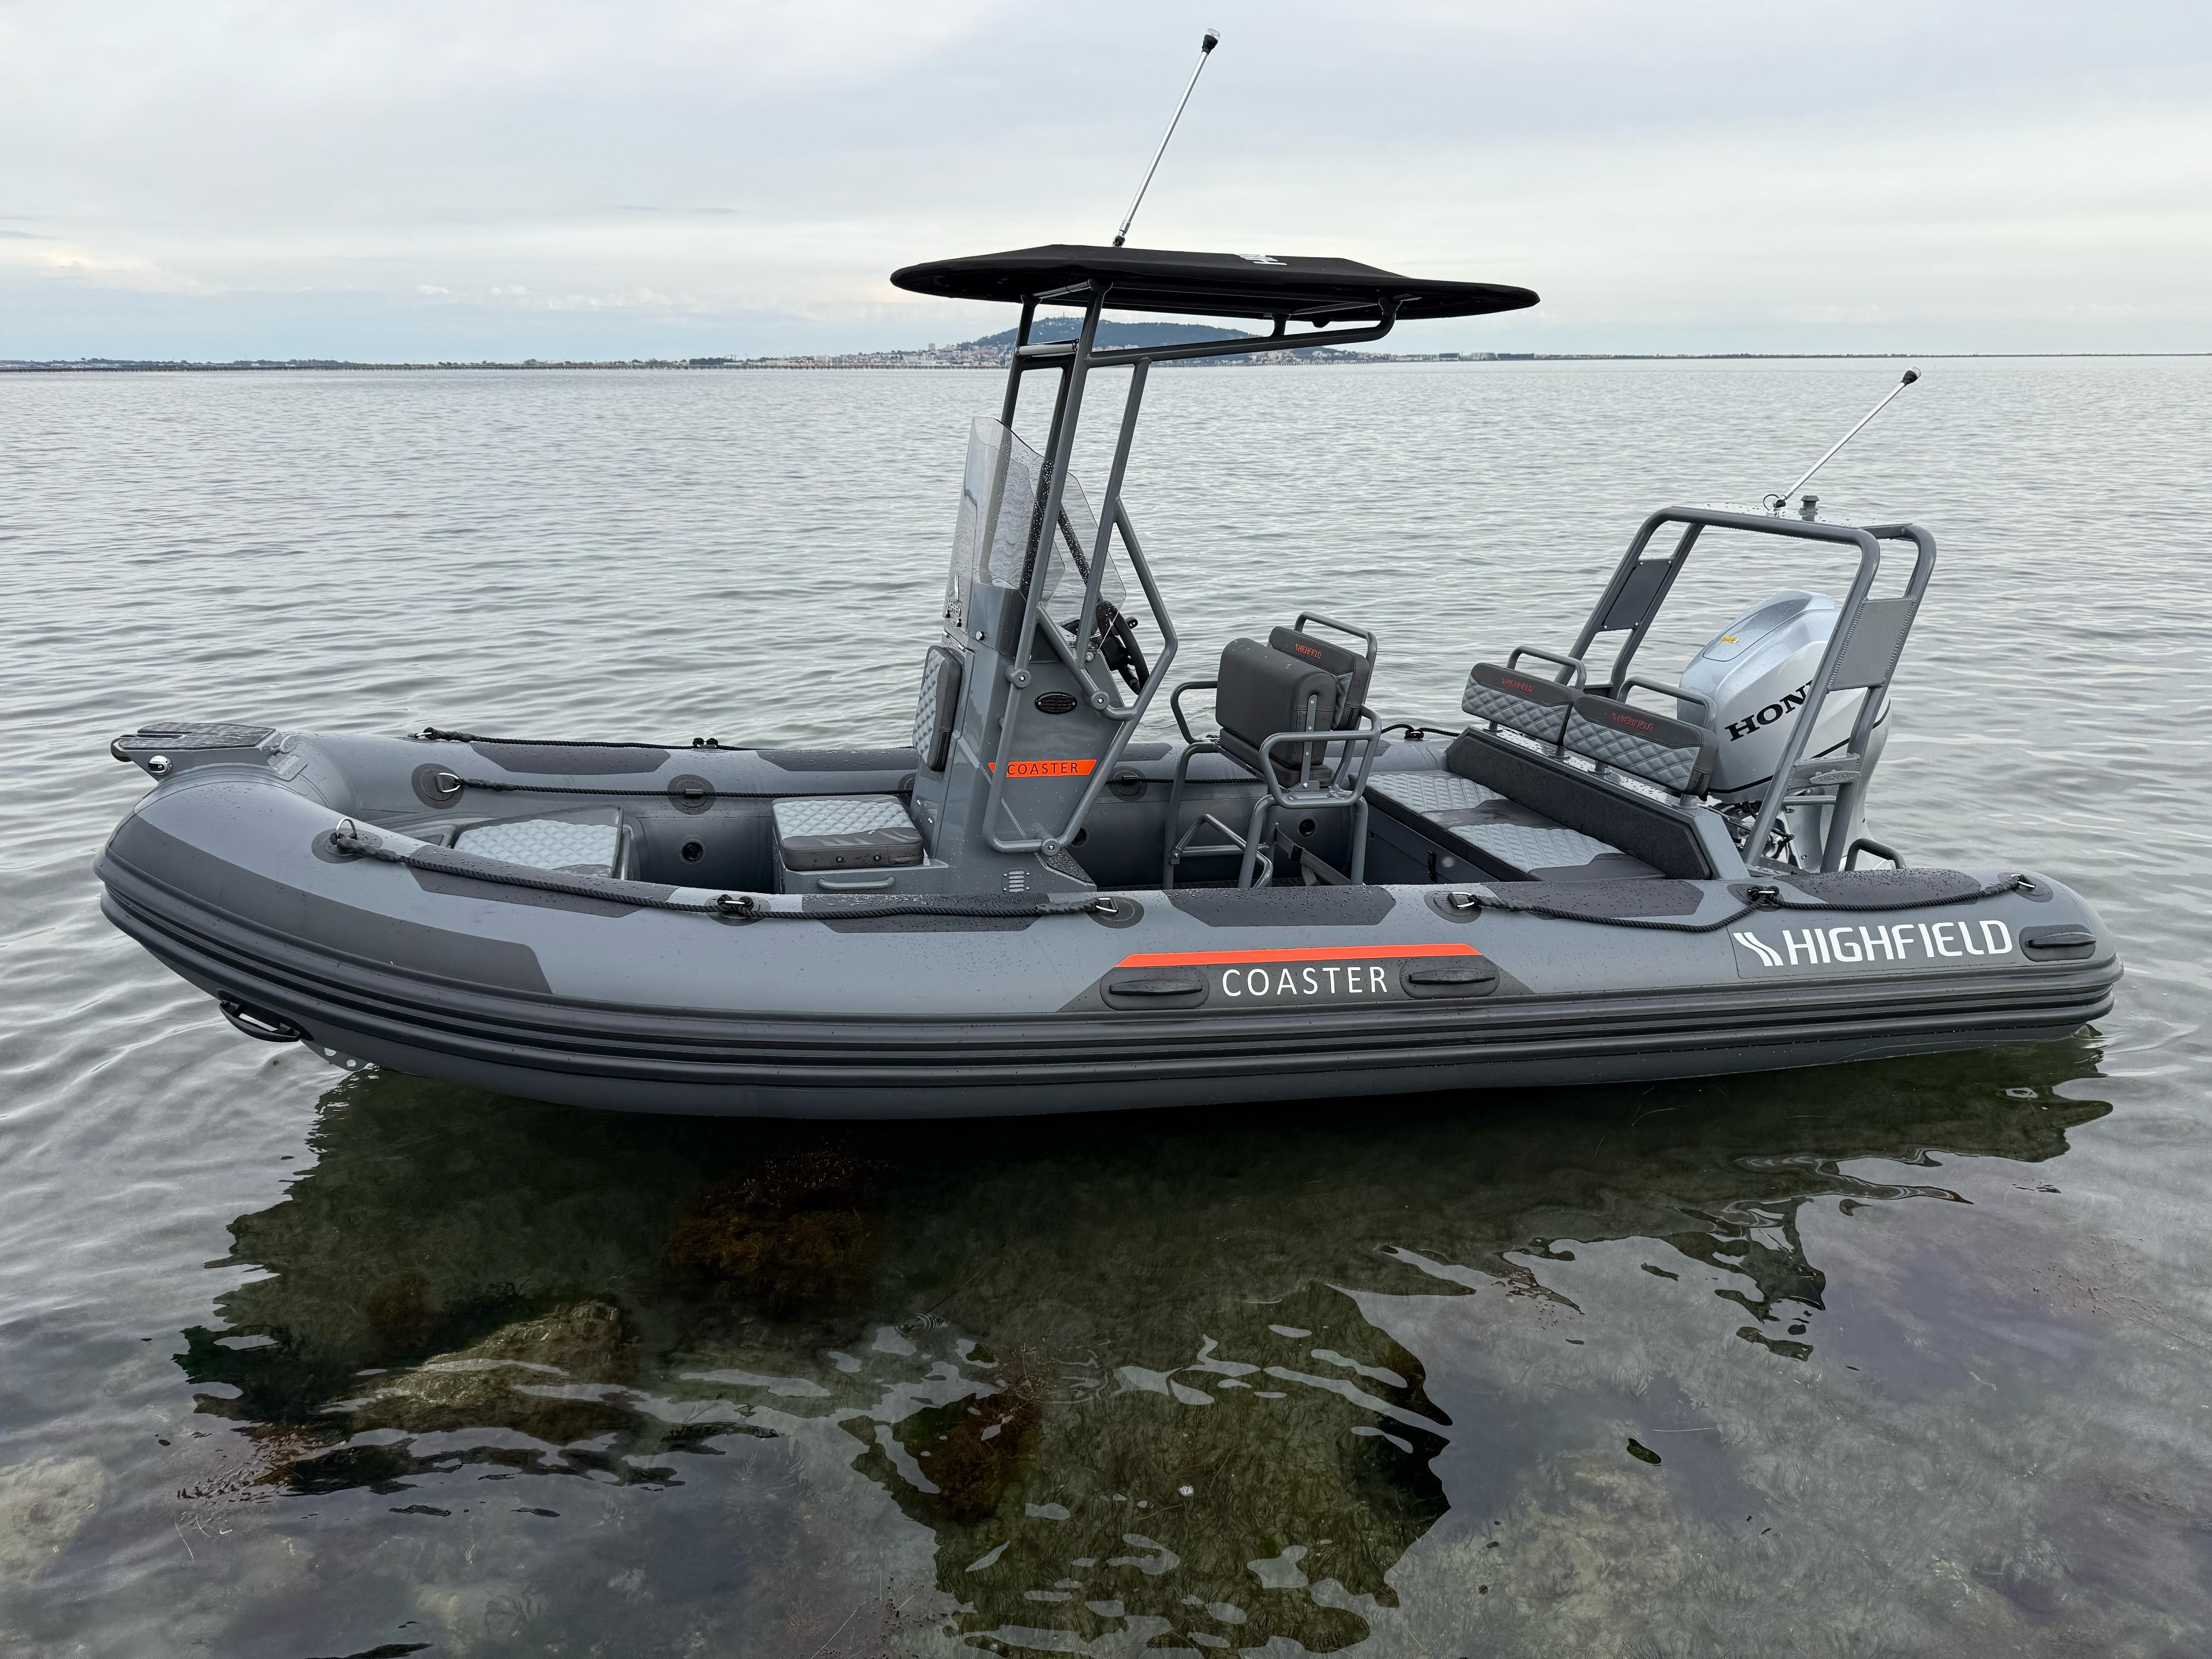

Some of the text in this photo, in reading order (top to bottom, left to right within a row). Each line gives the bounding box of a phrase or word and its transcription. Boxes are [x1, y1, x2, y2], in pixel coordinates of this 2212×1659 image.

[1007, 763, 1078, 775] COASTER
[1782, 920, 2012, 965] HIGHFIELD
[1222, 966, 1387, 997] COASTER
